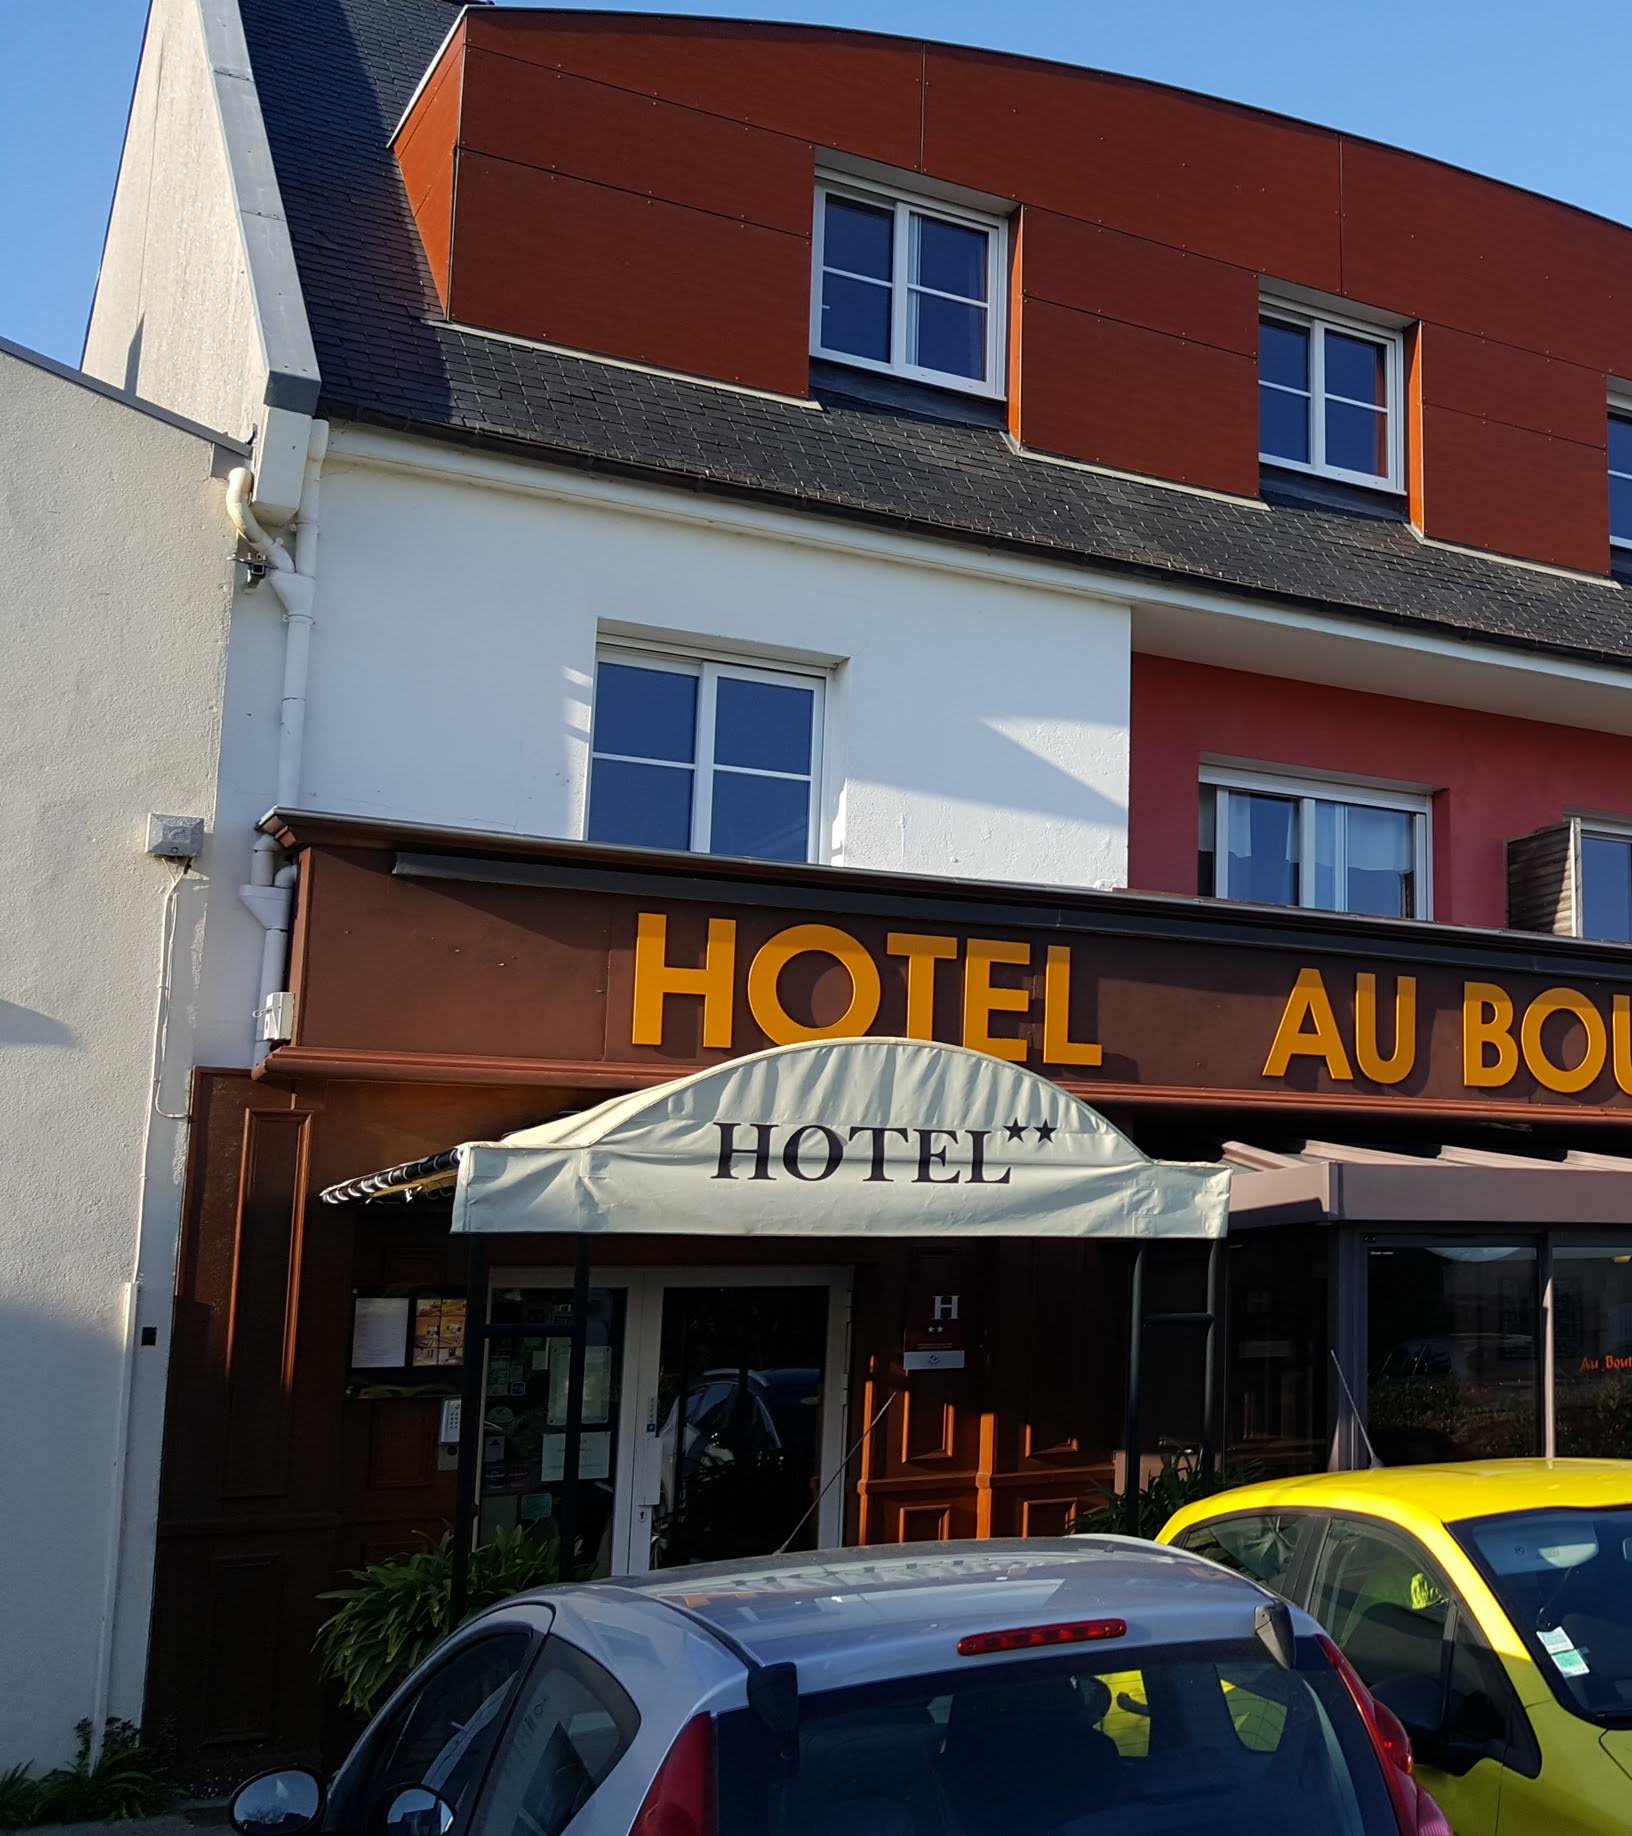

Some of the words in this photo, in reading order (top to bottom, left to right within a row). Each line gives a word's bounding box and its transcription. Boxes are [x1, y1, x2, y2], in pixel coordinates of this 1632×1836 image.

[632, 912, 1103, 1066] HOTEL
[1262, 967, 1418, 1085] AU
[710, 1121, 1012, 1184] HOTEL
[931, 1295, 961, 1320] H
[1580, 1357, 1599, 1370] Au
[1605, 1354, 1632, 1369] Bout
